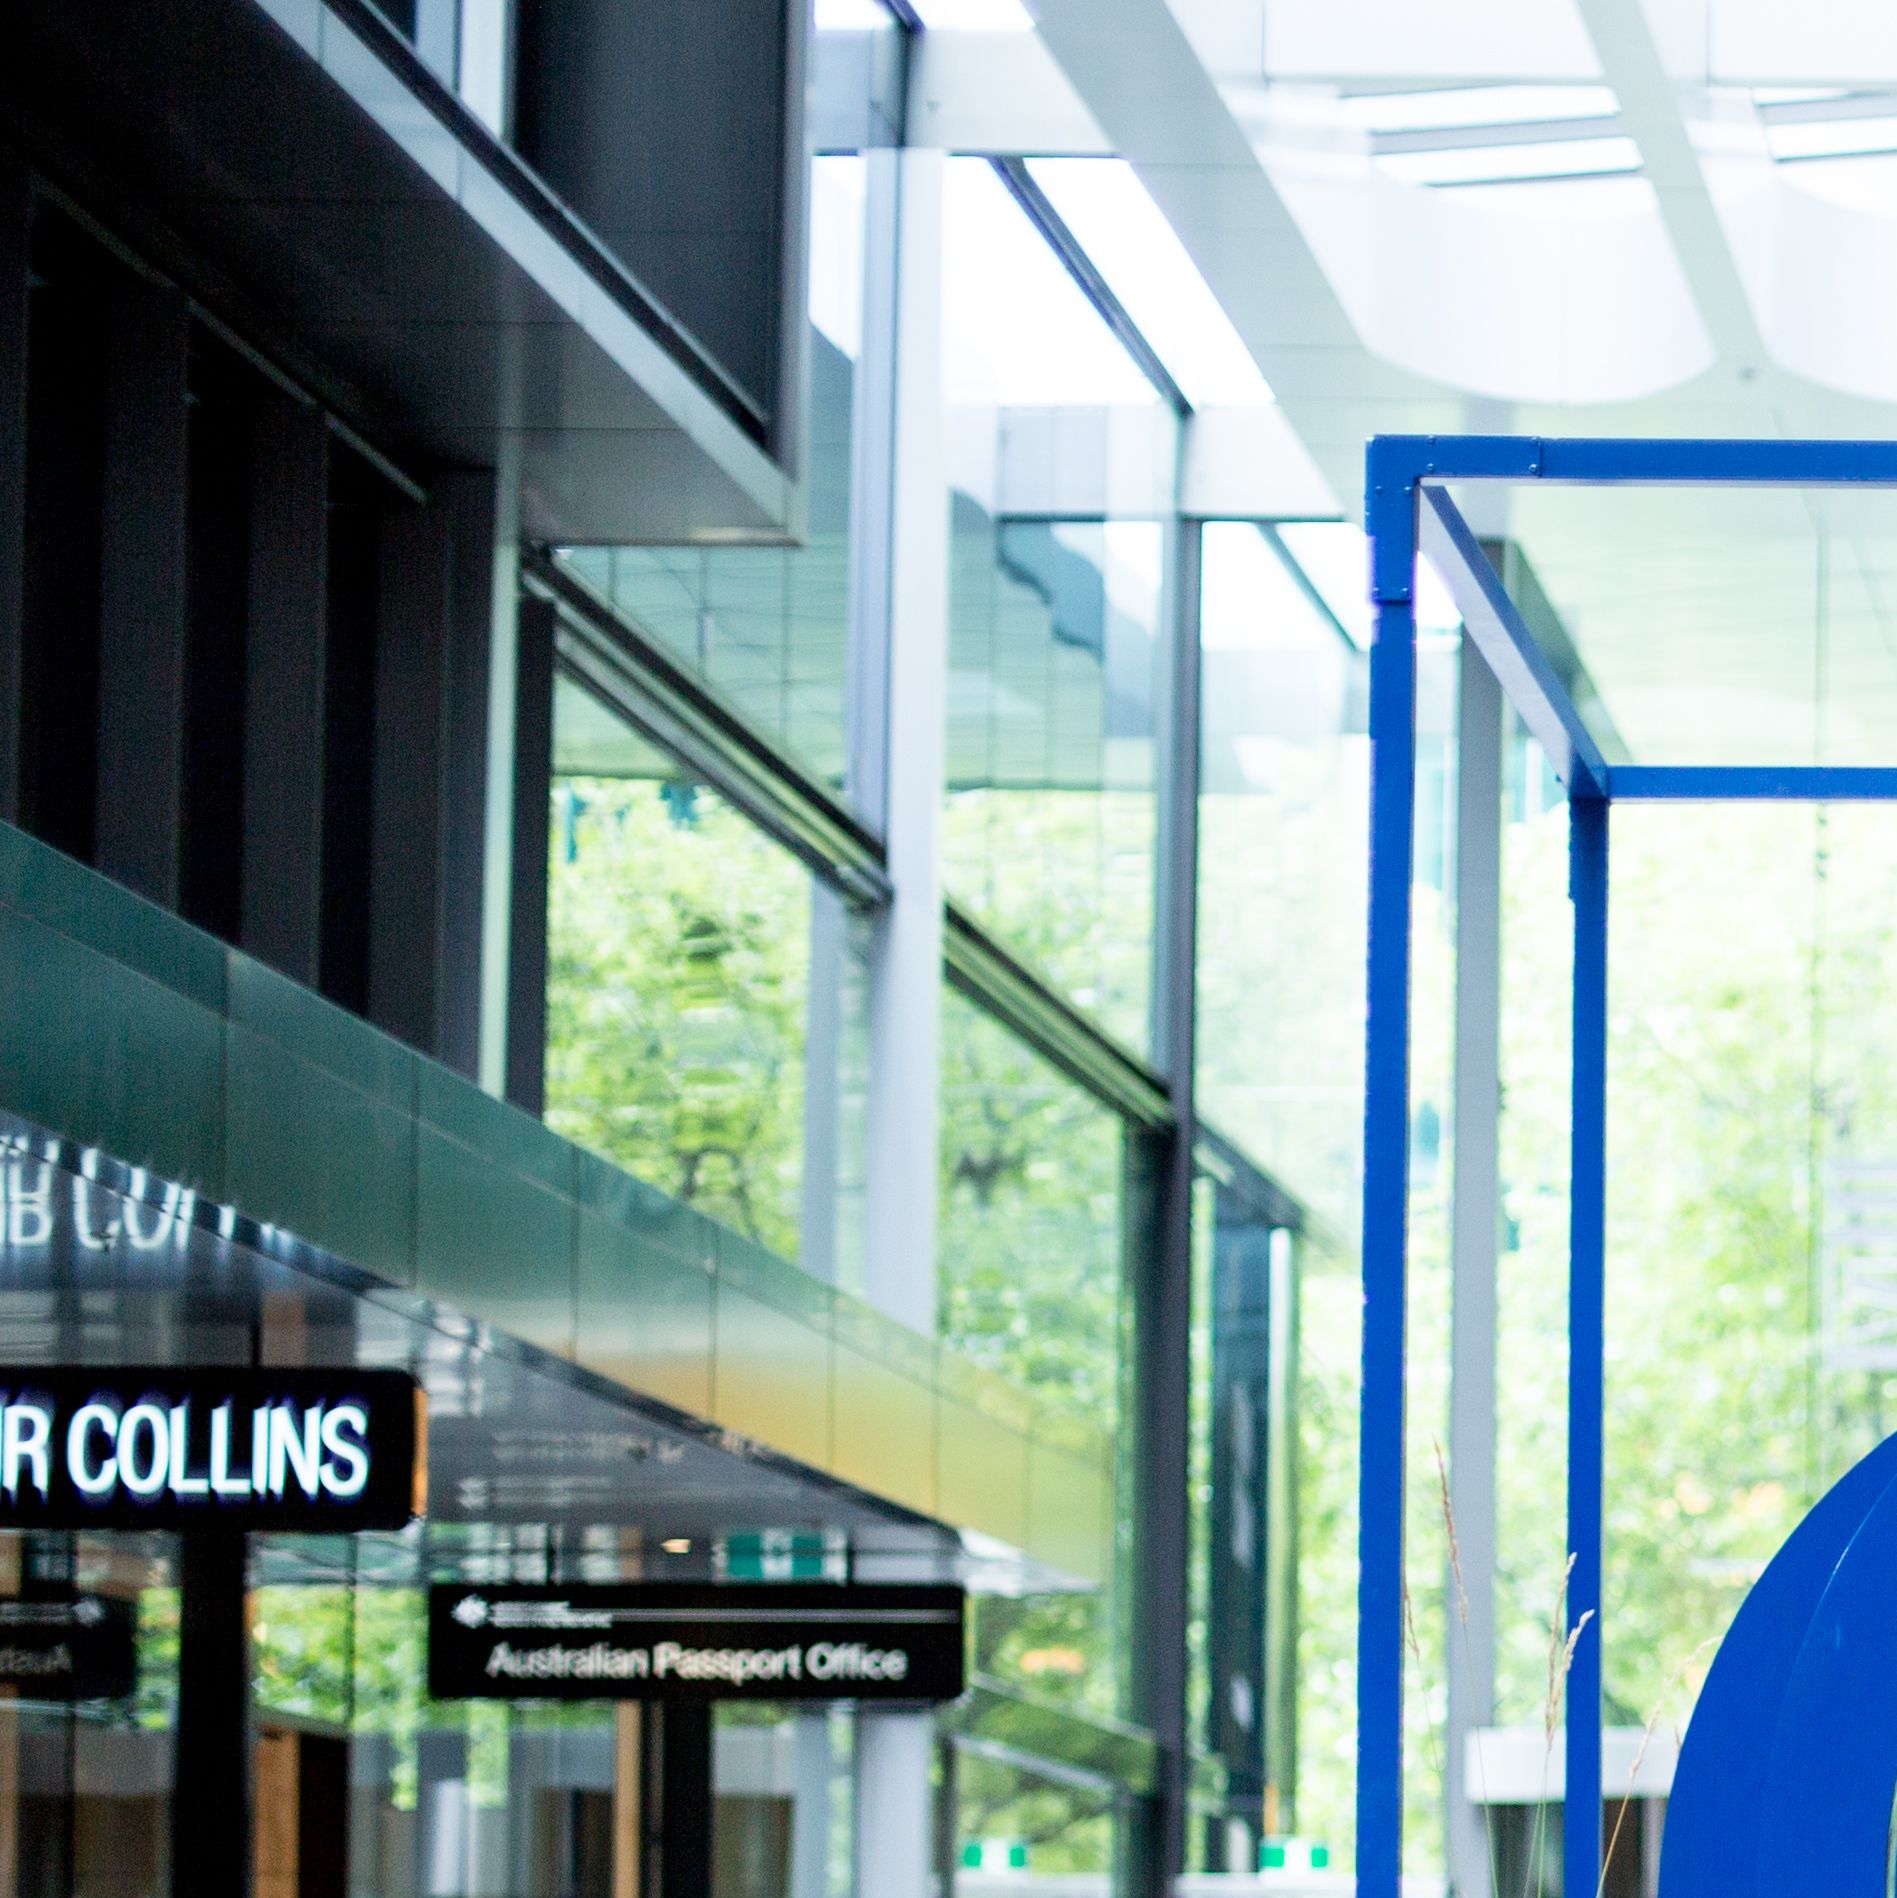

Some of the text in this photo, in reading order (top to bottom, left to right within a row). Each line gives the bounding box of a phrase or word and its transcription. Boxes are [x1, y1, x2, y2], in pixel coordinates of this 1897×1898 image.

[66, 1403, 370, 1498] COLLINS
[486, 1641, 909, 1685] Australian Passport Office
